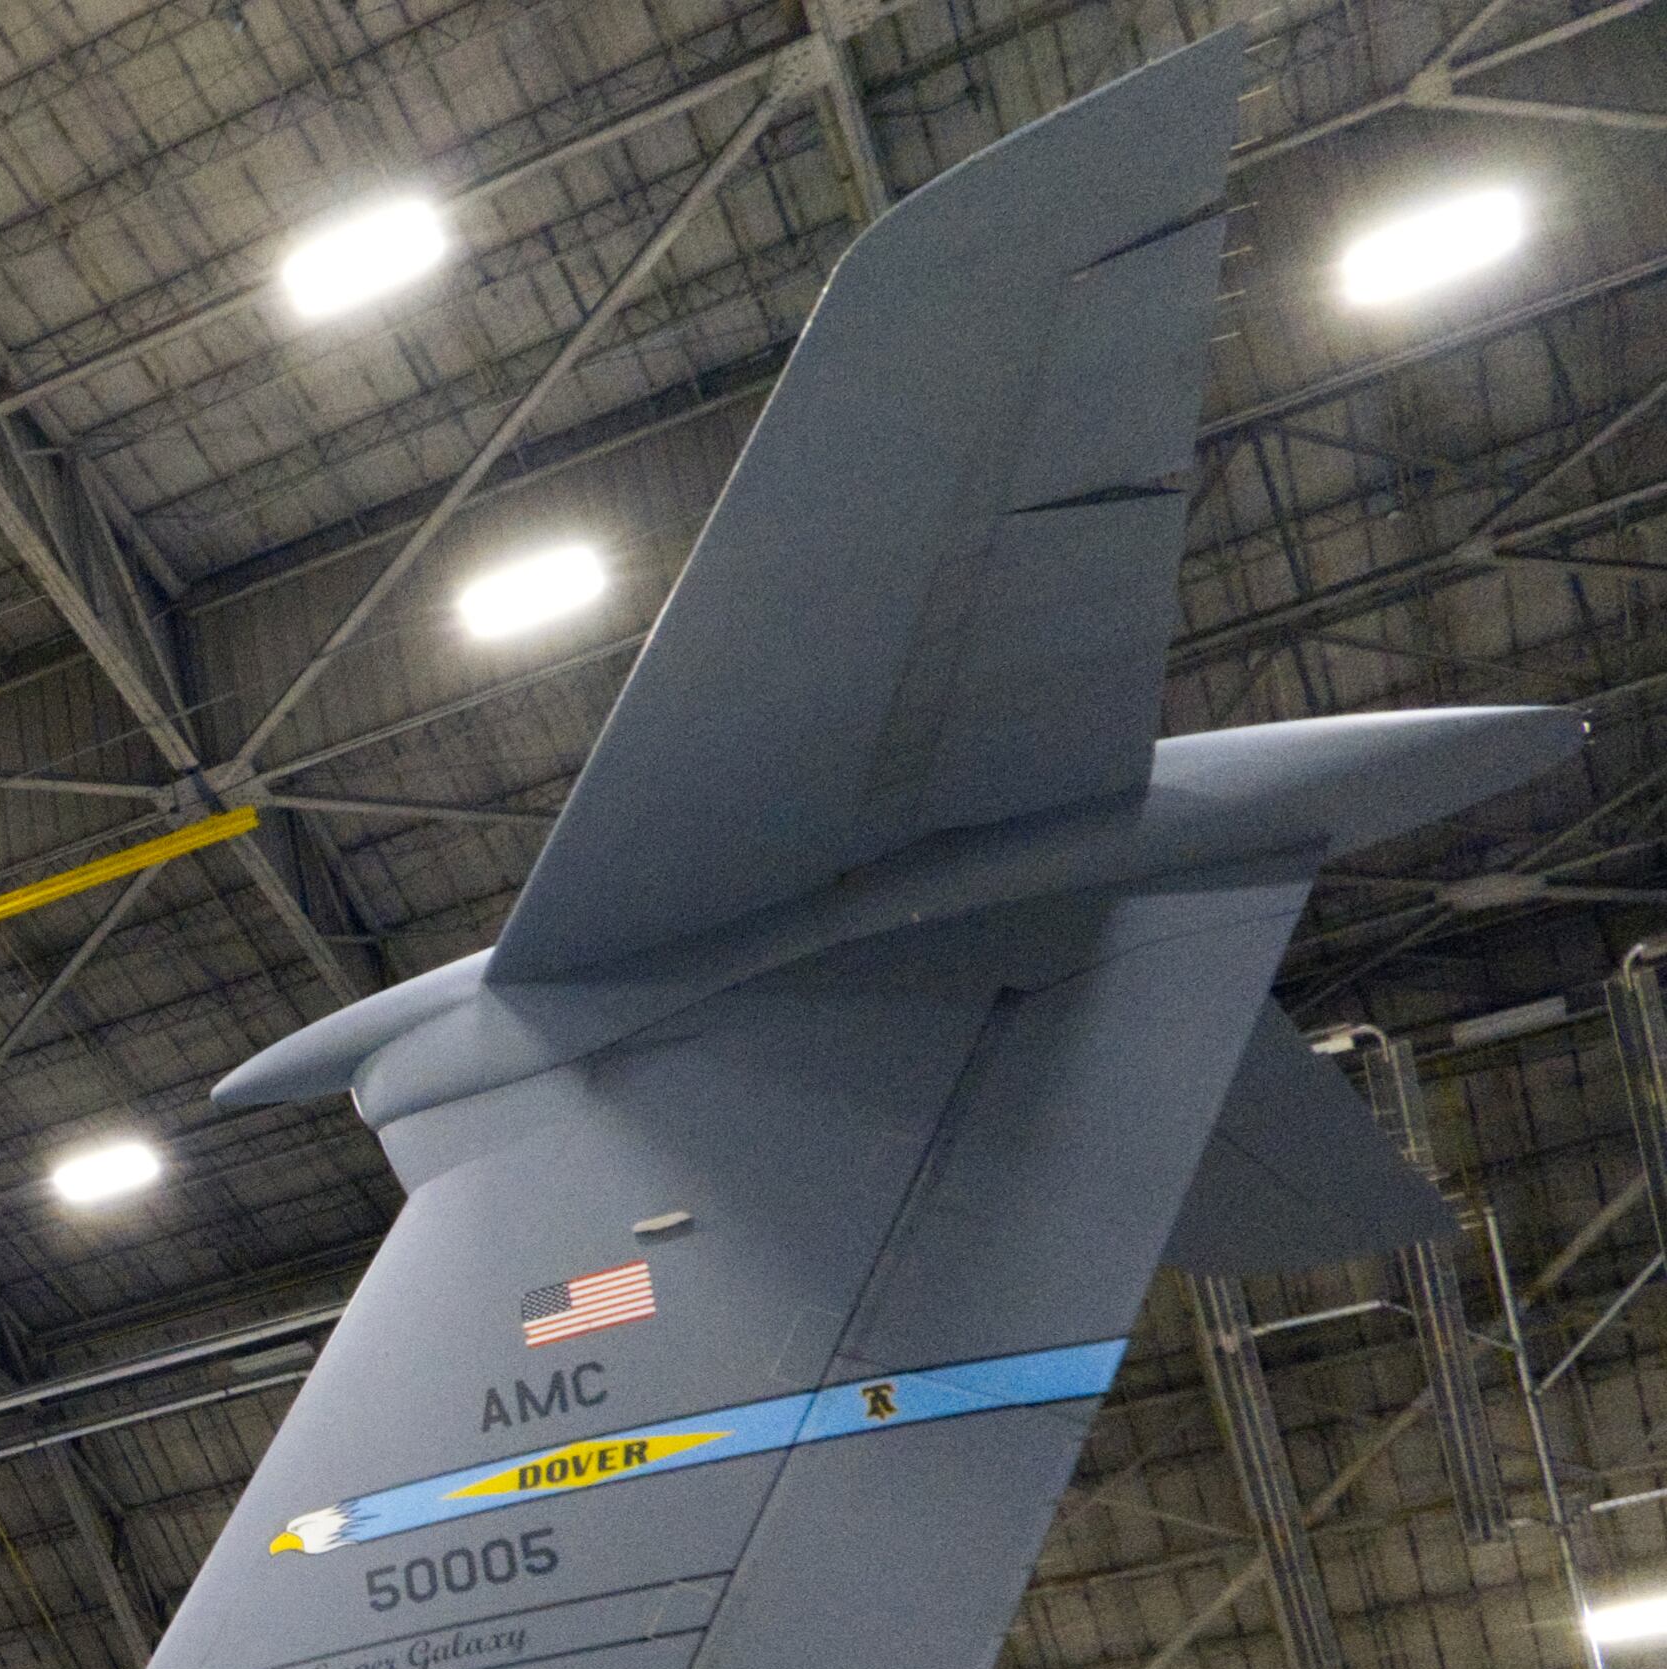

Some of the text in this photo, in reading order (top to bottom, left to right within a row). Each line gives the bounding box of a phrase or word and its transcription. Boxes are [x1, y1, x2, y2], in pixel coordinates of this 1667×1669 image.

[481, 1361, 608, 1433] AMC
[518, 1440, 650, 1490] DOVER
[366, 1527, 560, 1612] 50005
